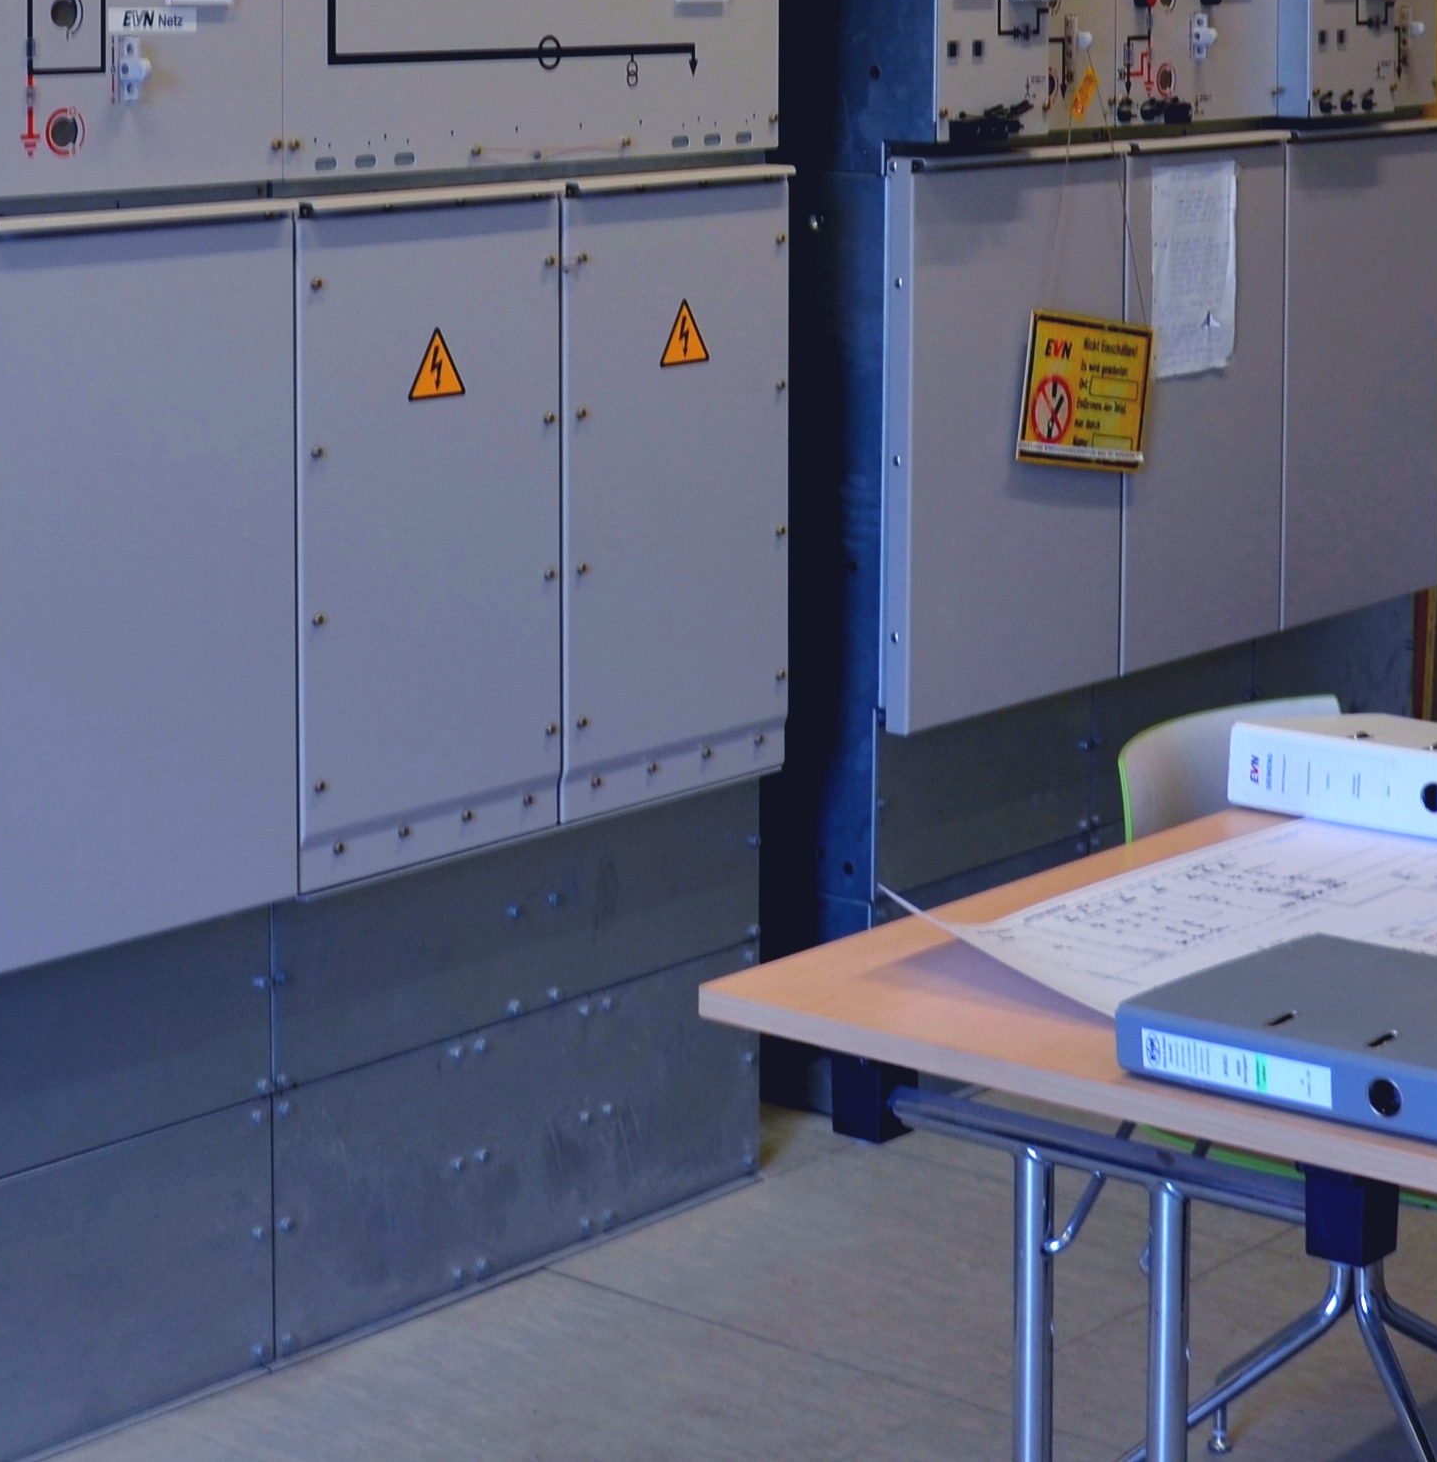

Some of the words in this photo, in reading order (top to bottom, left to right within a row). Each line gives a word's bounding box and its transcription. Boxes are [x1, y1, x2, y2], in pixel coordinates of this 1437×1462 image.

[123, 10, 154, 27] EVN
[158, 14, 183, 27] Netz
[1044, 338, 1073, 360] EVN
[1083, 338, 1100, 351] Nicht
[1250, 753, 1260, 784] EVN
